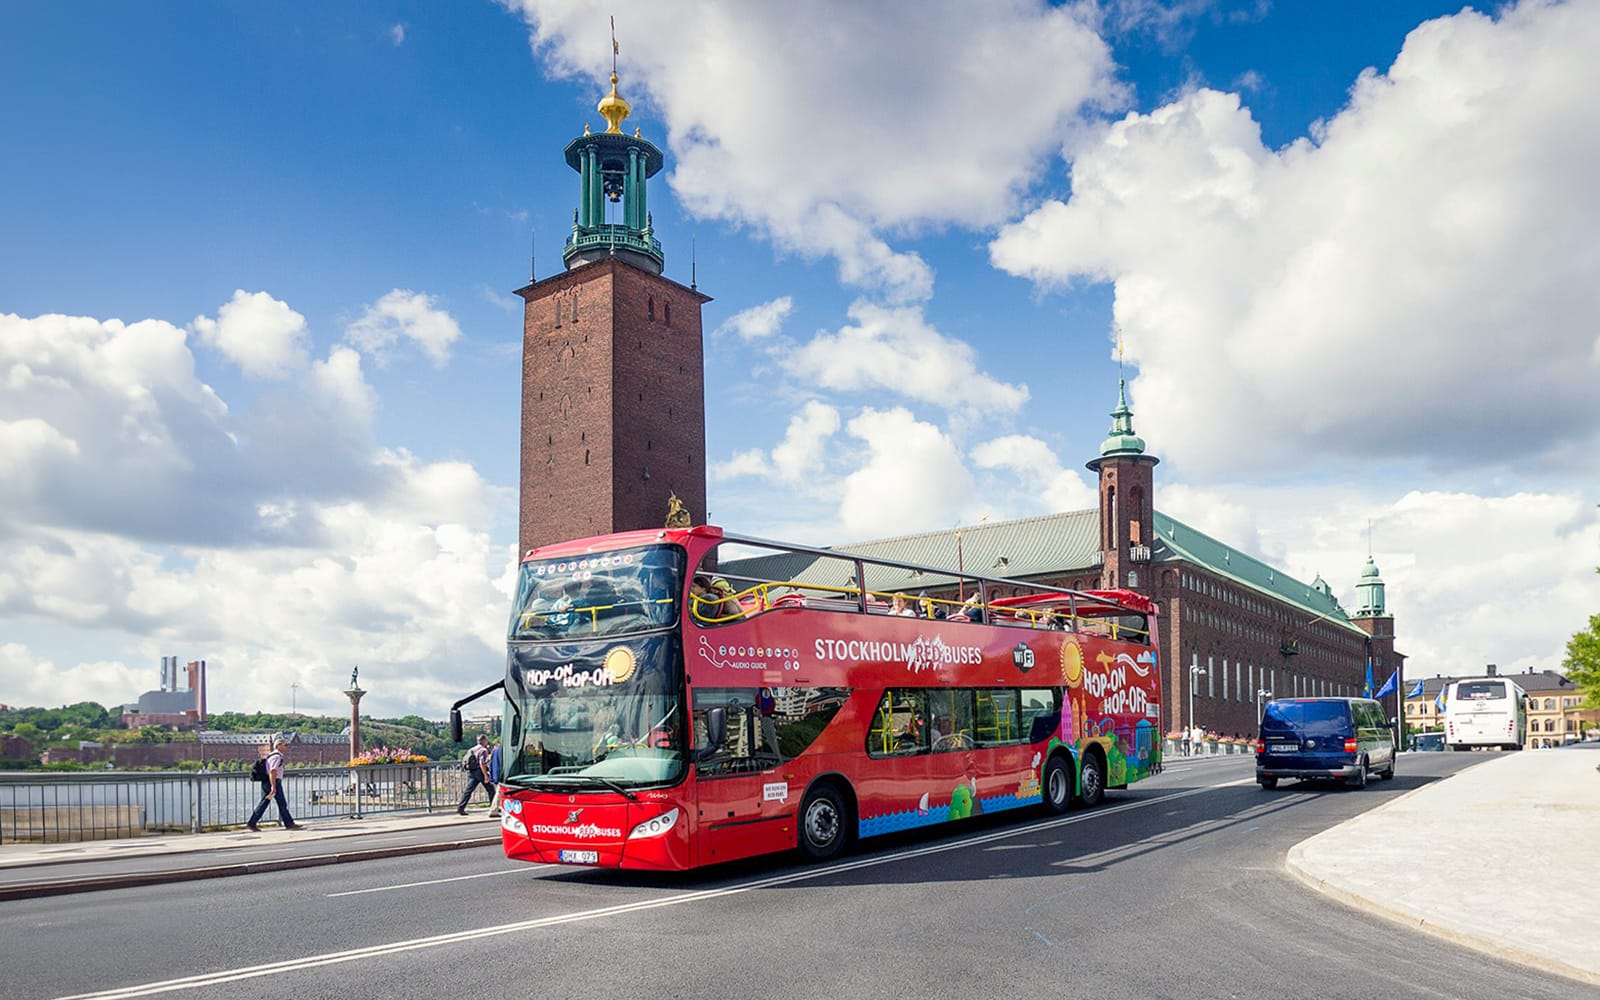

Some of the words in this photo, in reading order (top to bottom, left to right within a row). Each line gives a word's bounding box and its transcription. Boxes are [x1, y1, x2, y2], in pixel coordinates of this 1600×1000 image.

[815, 638, 912, 663] STOCKHOLM
[944, 645, 982, 665] BUSES
[527, 663, 573, 686] HOP-ON
[731, 662, 750, 670] AUDIO
[750, 662, 767, 670] GUIDE
[563, 668, 616, 688] HOP-OFF
[1083, 665, 1127, 698] HOP-ON
[1103, 685, 1147, 715] HOP-OFF
[532, 824, 577, 836] STOCKHOLM
[596, 828, 621, 838] BUSES
